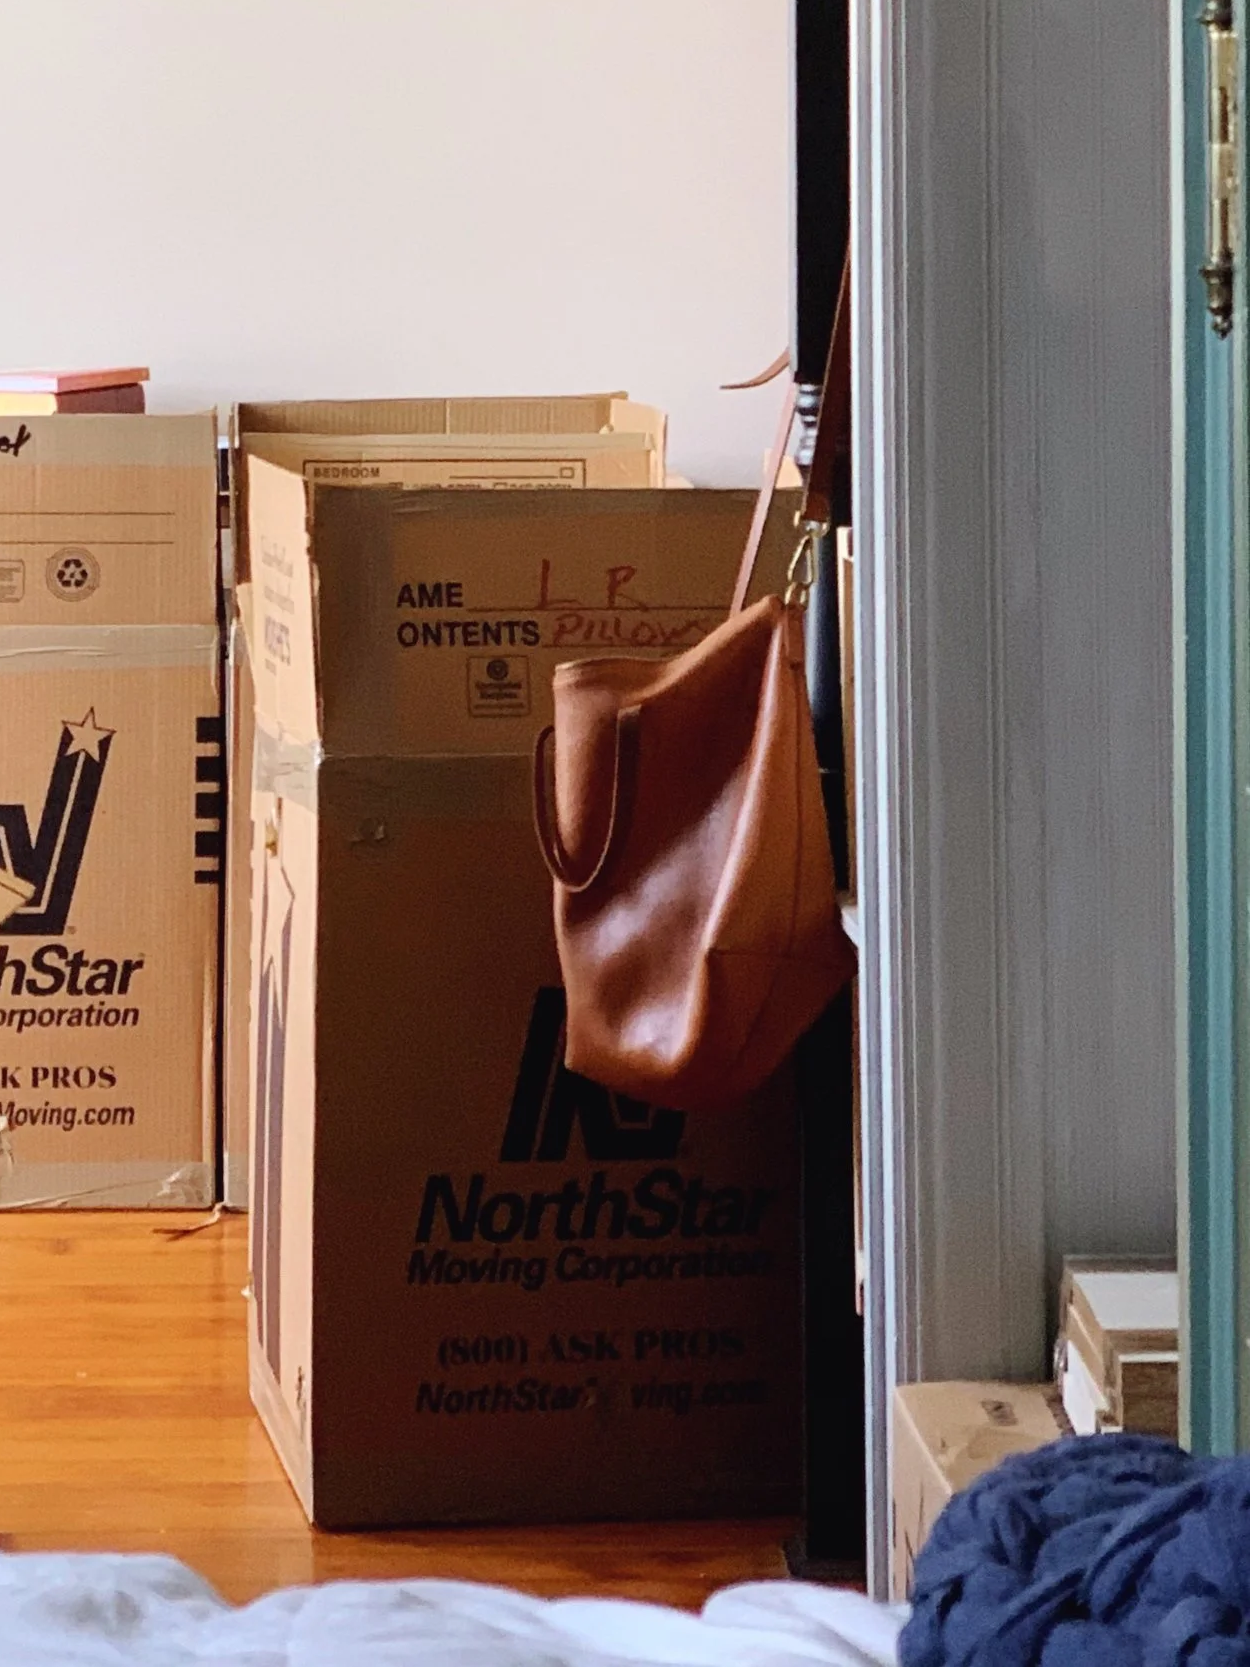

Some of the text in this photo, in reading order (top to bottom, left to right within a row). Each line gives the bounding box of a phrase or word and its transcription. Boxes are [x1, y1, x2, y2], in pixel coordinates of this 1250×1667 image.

[313, 467, 381, 479] BEDROOM
[31, 1065, 118, 1089] PROS
[415, 1168, 780, 1243] NorthStar
[407, 1246, 774, 1290] Moving Corporation
